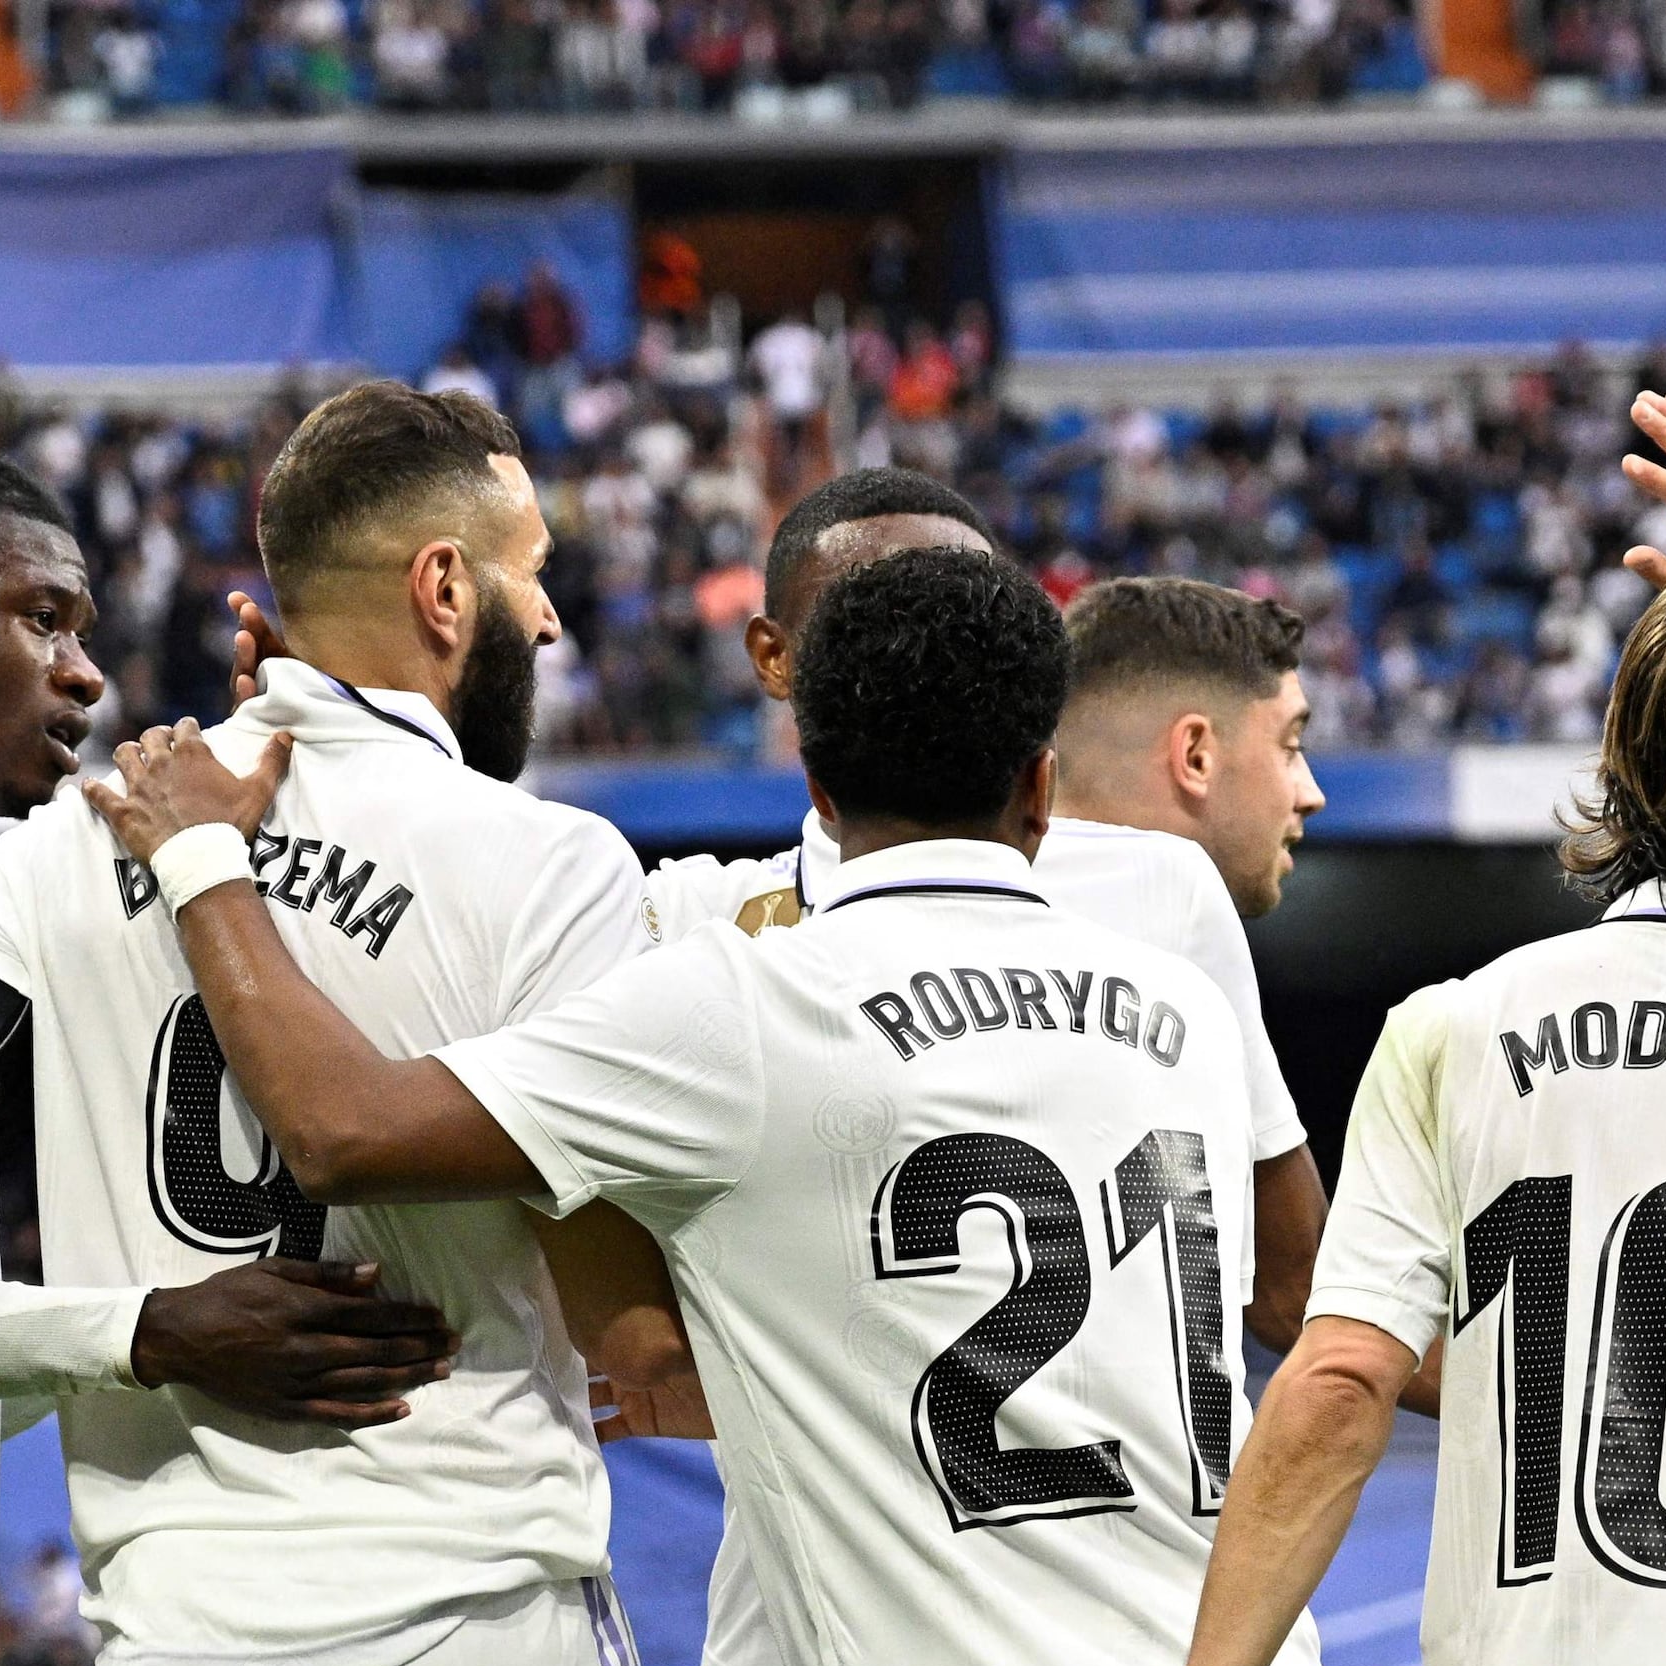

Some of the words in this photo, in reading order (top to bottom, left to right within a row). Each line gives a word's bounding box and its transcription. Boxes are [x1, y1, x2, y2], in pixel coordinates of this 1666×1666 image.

[114, 826, 414, 960] BZEMA
[859, 966, 1188, 1068] RODRYGO
[870, 1128, 1233, 1533] 21
